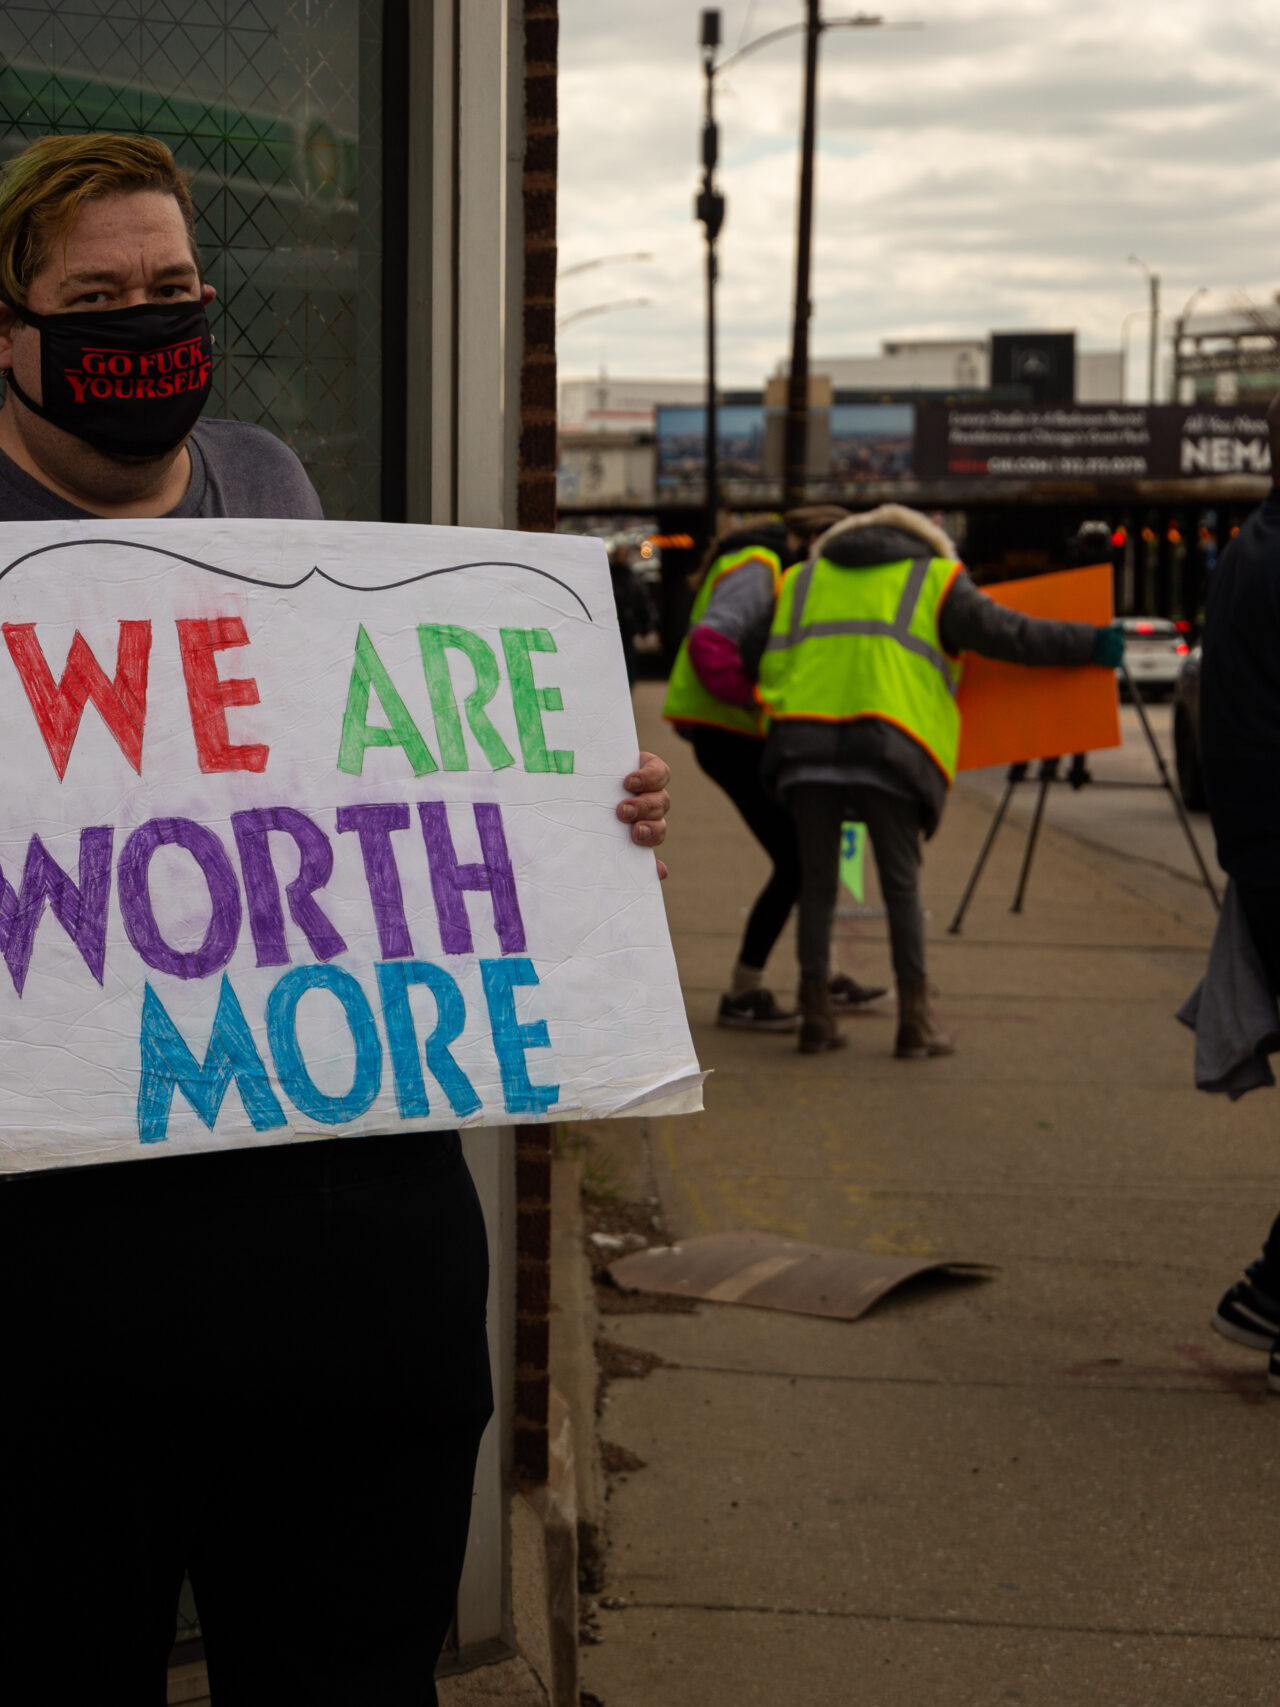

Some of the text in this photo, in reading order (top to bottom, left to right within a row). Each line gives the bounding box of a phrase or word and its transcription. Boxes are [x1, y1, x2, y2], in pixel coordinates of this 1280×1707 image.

[65, 364, 212, 403] YOURSELF
[82, 342, 204, 376] GO FUCK
[0, 616, 575, 783] WE ARE
[138, 957, 561, 1144] MORE
